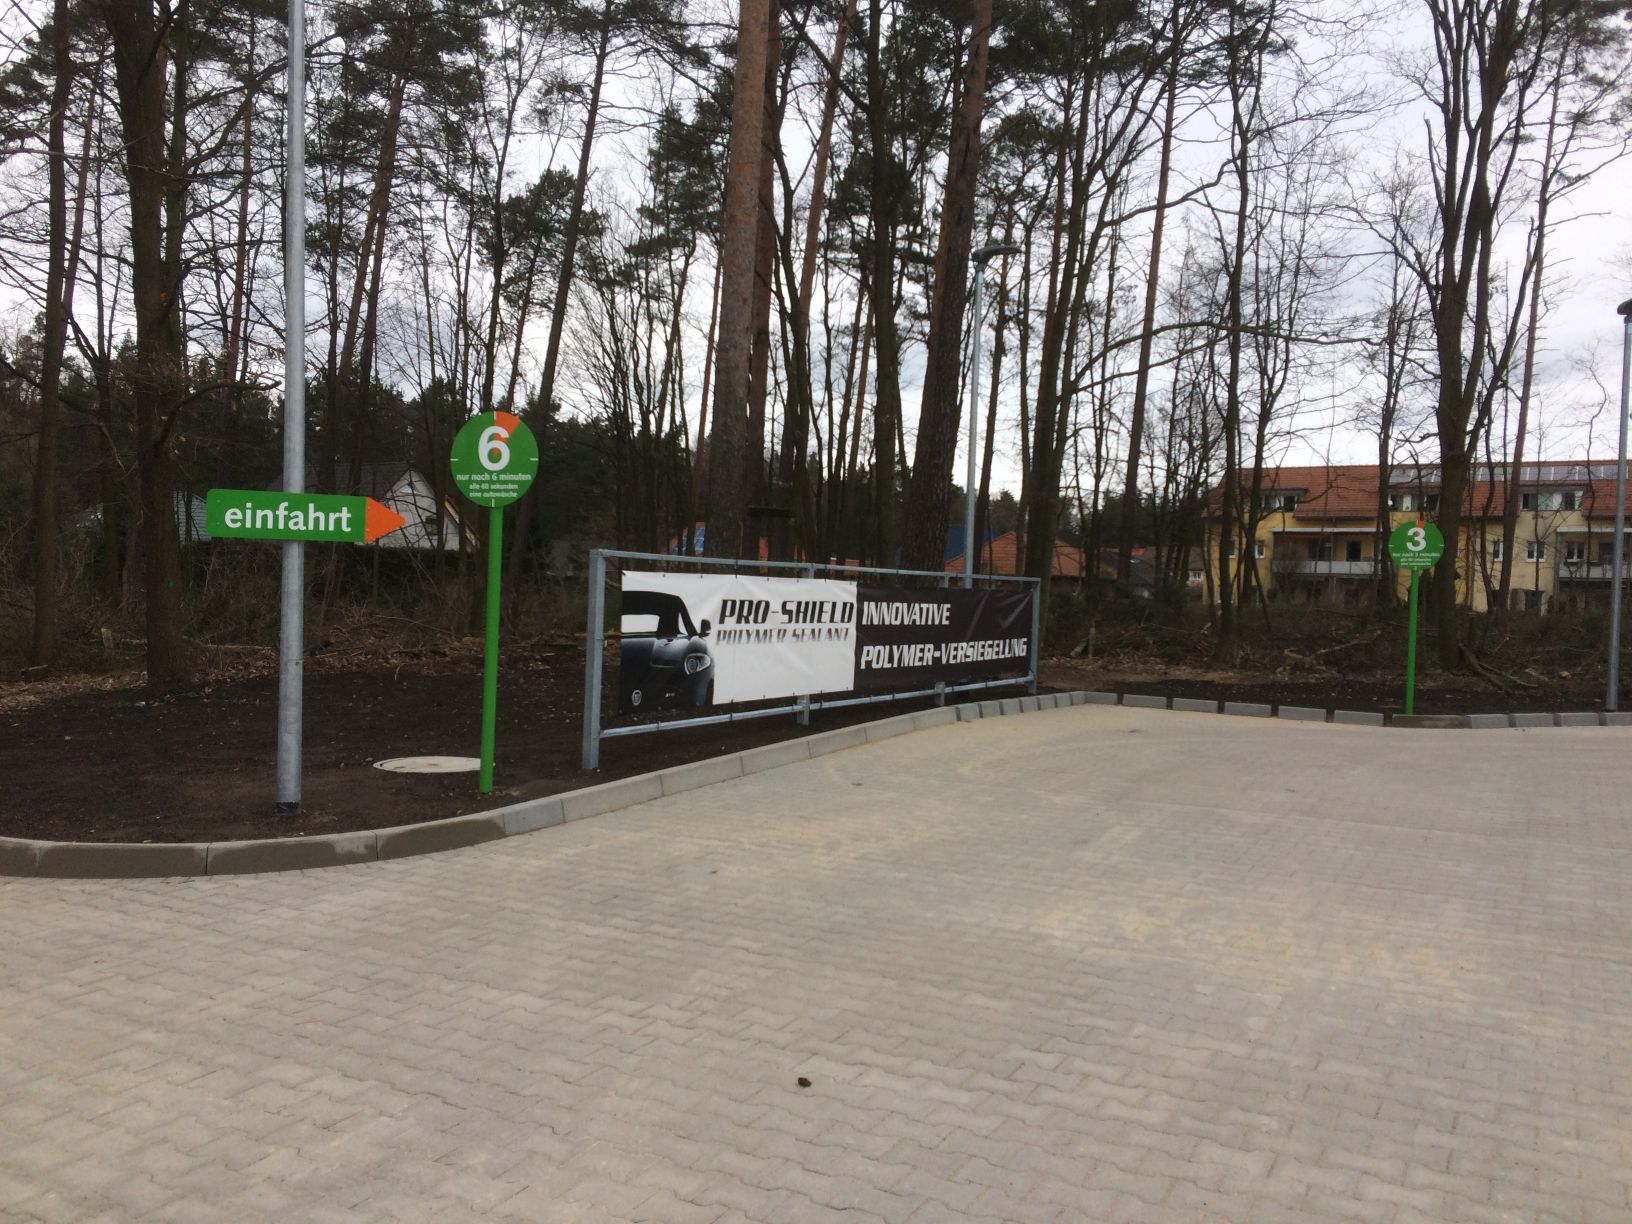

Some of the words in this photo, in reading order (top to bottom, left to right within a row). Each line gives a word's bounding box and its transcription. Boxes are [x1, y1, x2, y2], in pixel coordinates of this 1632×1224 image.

[478, 426, 510, 471] 6
[471, 472, 490, 481] noch
[492, 473, 498, 481] 6
[499, 473, 531, 481] minuten
[224, 501, 352, 532] einfahrt
[1406, 528, 1427, 552] 3
[718, 598, 855, 626] PRO-SHIELD
[861, 601, 951, 626] INNOVATIVE
[716, 628, 787, 645] POLYMER
[860, 637, 1028, 670] POLYMER-VERSIEGELUNG
